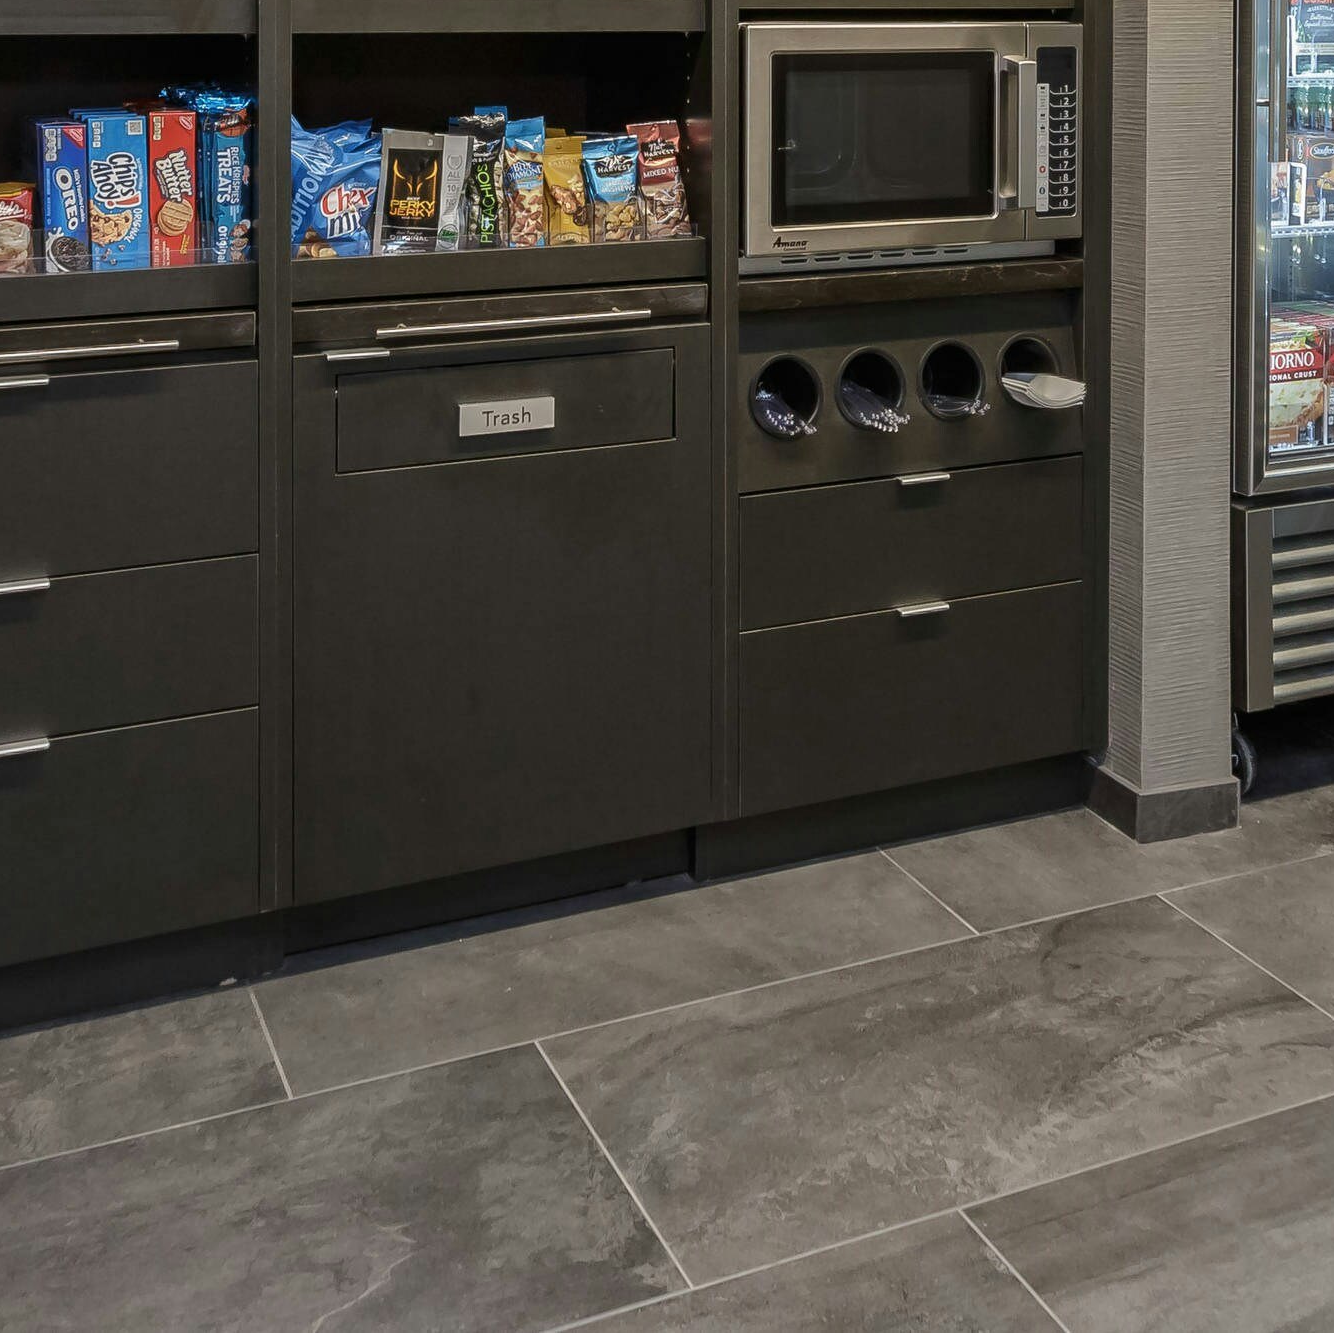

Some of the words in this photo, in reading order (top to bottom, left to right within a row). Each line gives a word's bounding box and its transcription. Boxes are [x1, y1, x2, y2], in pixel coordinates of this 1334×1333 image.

[230, 146, 240, 166] RICE
[643, 149, 676, 159] HARVEST
[108, 151, 137, 199] Chips
[155, 159, 184, 204] Butter
[168, 149, 194, 197] Nutter
[217, 149, 233, 204] TREATS
[230, 166, 240, 205] KRISPIES
[643, 168, 667, 180] MIXED
[54, 166, 79, 230] OREO
[320, 183, 378, 218] Chex
[388, 207, 436, 218] JERKY
[389, 199, 436, 209] PERKY
[479, 163, 496, 244] PISTACHIOS
[126, 208, 144, 243] ORIGINAL
[772, 236, 809, 249] Amana
[1294, 370, 1318, 378] CRUST
[482, 406, 531, 427] Trash
